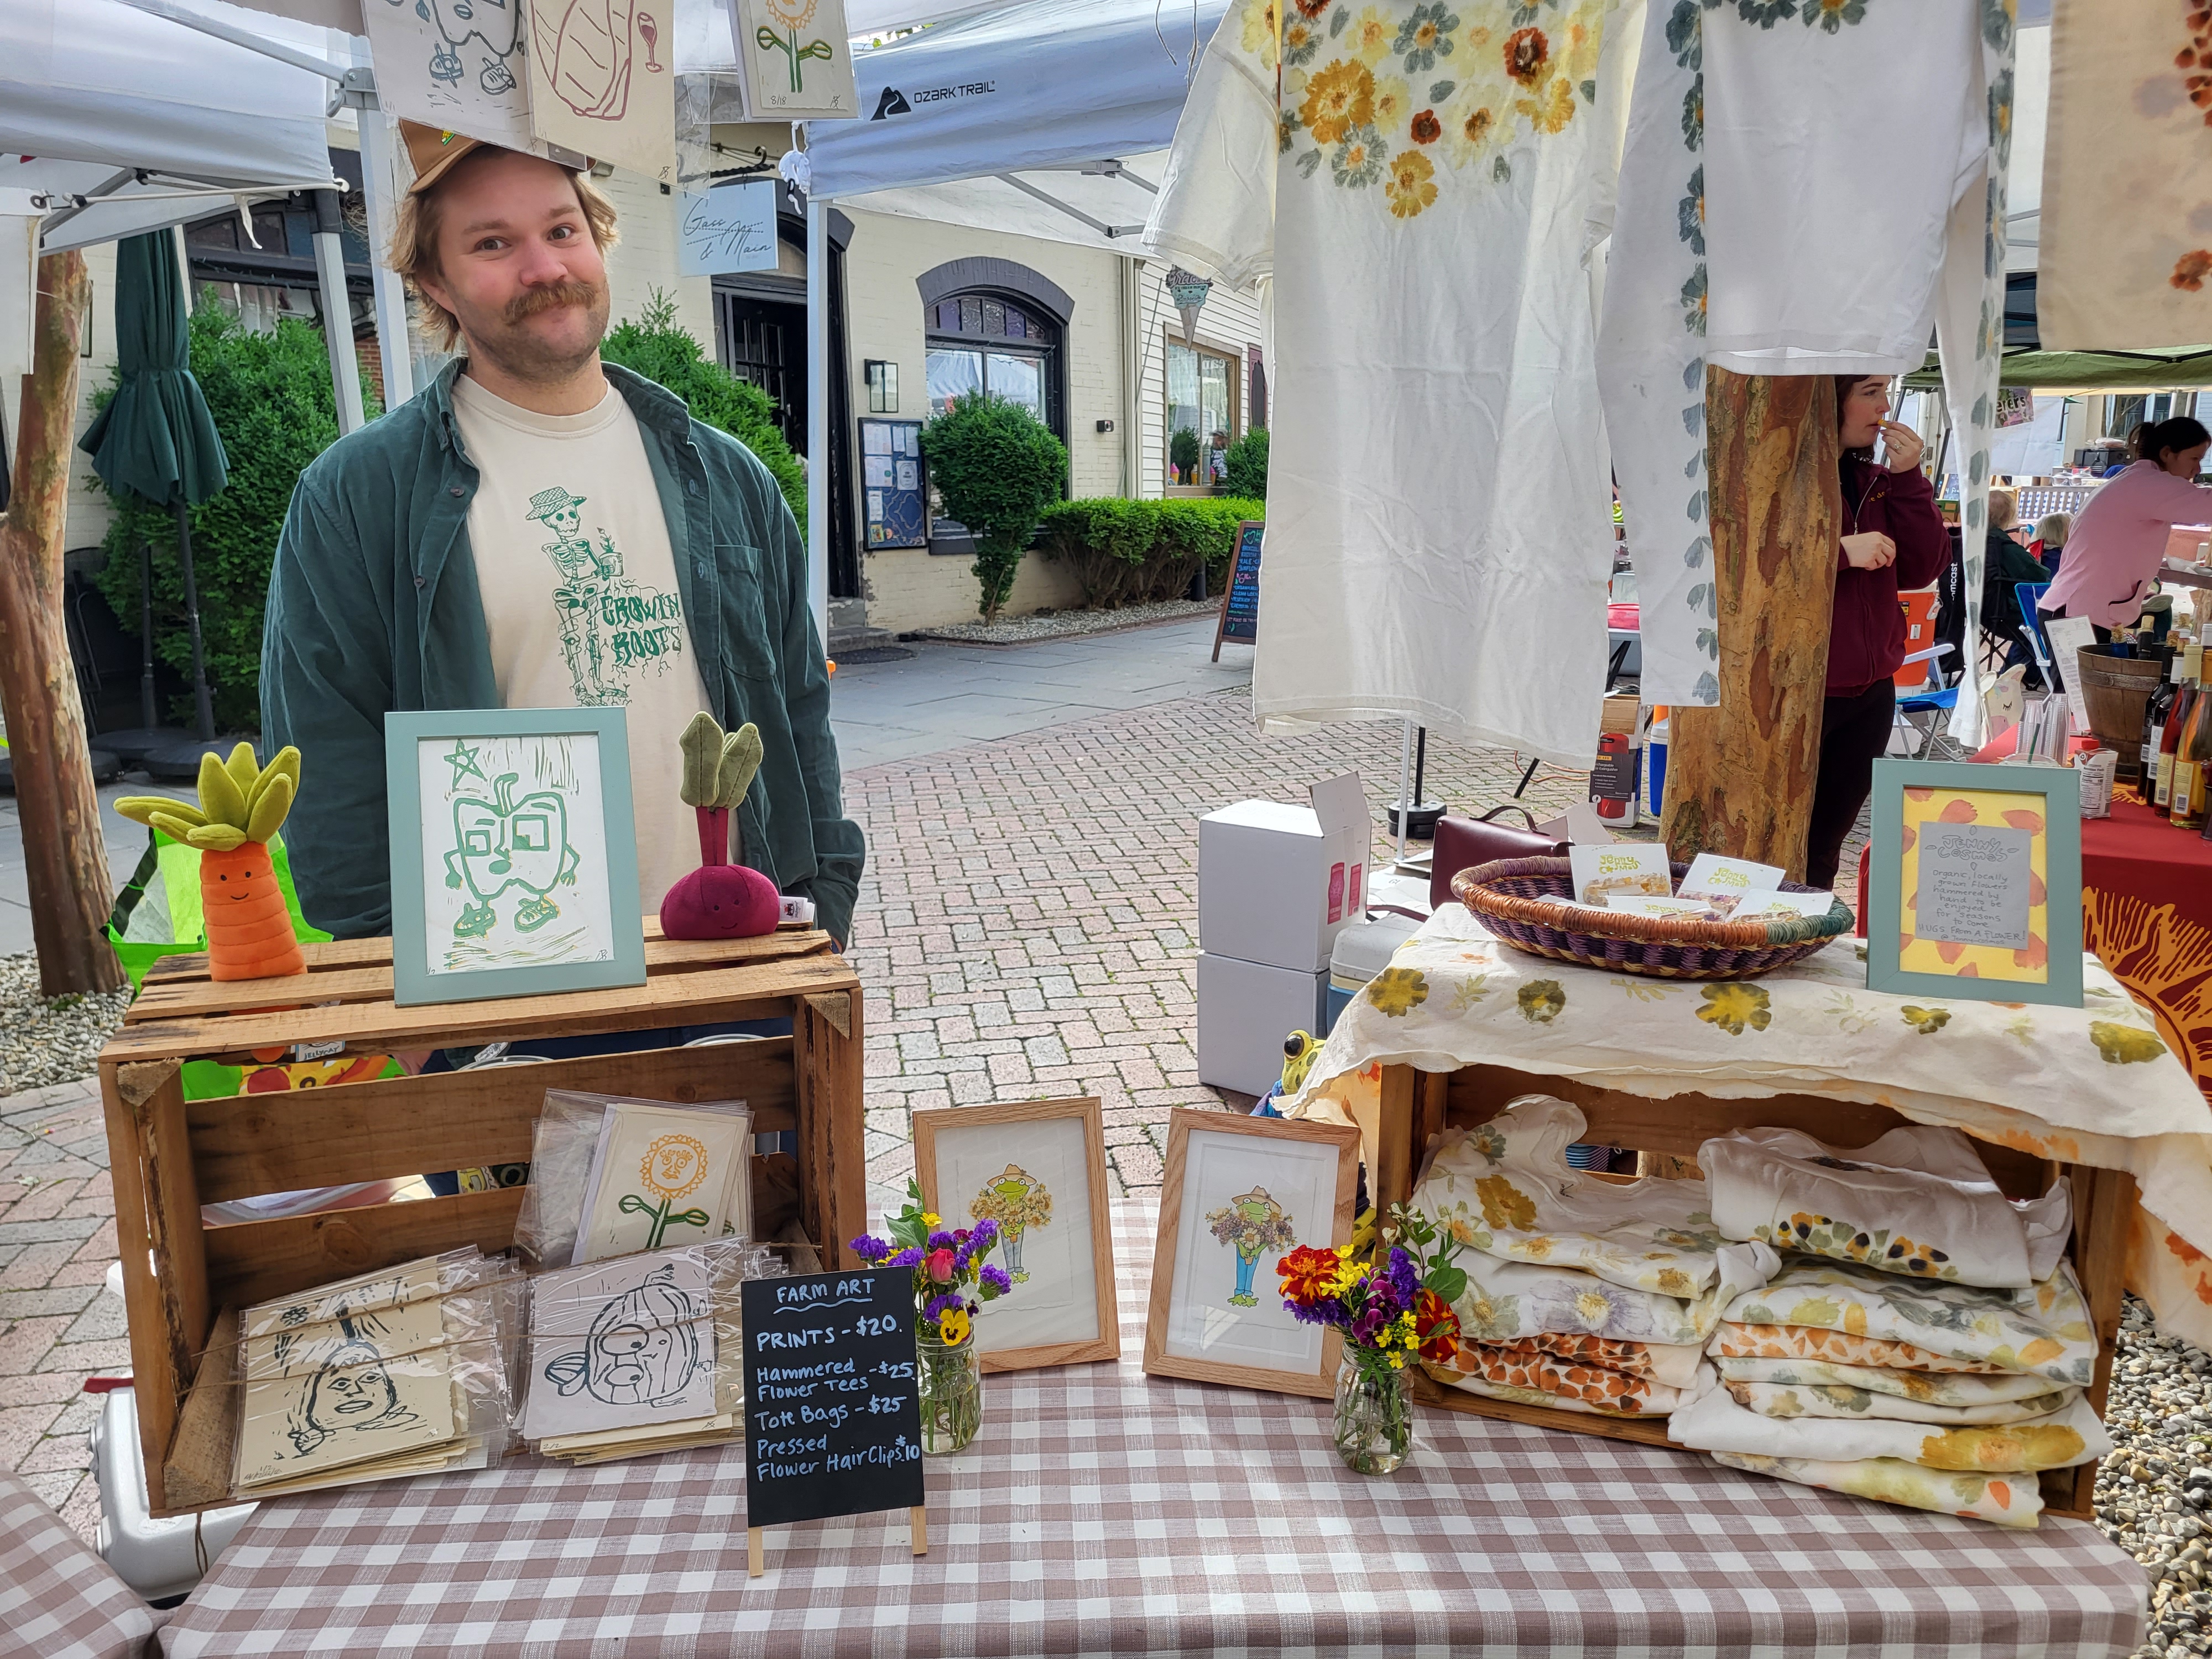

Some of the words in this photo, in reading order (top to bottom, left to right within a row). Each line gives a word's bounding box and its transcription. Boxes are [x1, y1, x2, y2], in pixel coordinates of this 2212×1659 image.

[770, 95, 787, 105] 8/18
[700, 242, 713, 260] &
[720, 221, 772, 266] Main
[1933, 885, 1984, 896] hammered
[1988, 891, 1999, 900] by
[1940, 894, 1966, 903] hand
[1918, 924, 1945, 932] HUGS
[776, 1281, 827, 1304] FARM
[836, 1278, 875, 1297] ART
[757, 1327, 836, 1352] PRINTS
[757, 1357, 855, 1383] Hammered
[757, 1383, 818, 1402] Flower
[824, 1376, 869, 1392] Tees
[801, 1404, 849, 1428] Bags
[757, 1433, 827, 1459] Pressed
[757, 1461, 820, 1482] Flower
